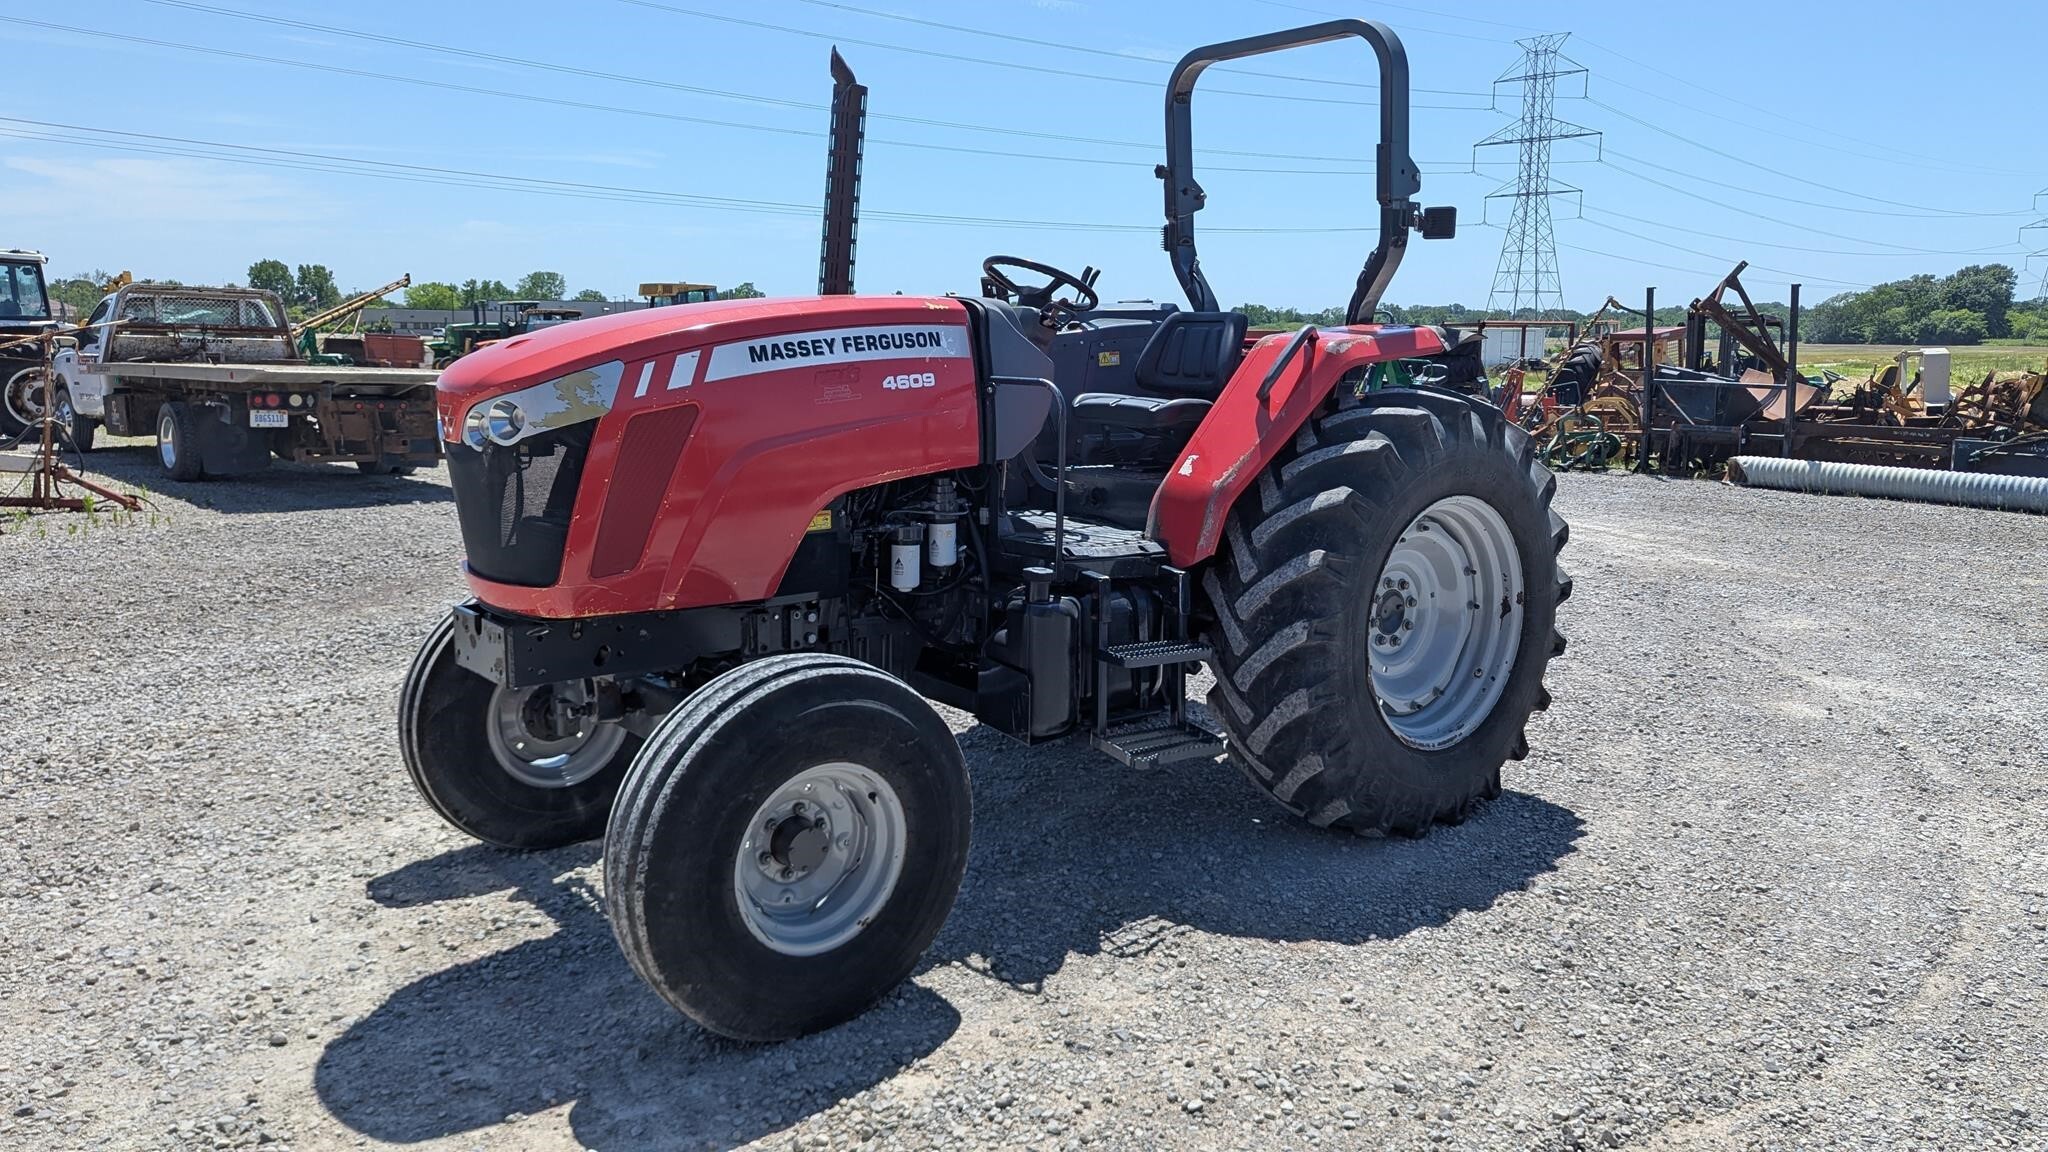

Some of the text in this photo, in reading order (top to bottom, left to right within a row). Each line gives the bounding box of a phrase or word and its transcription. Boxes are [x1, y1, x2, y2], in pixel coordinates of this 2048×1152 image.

[748, 331, 942, 363] MASSEY FERGUSON
[882, 373, 936, 390] 4609
